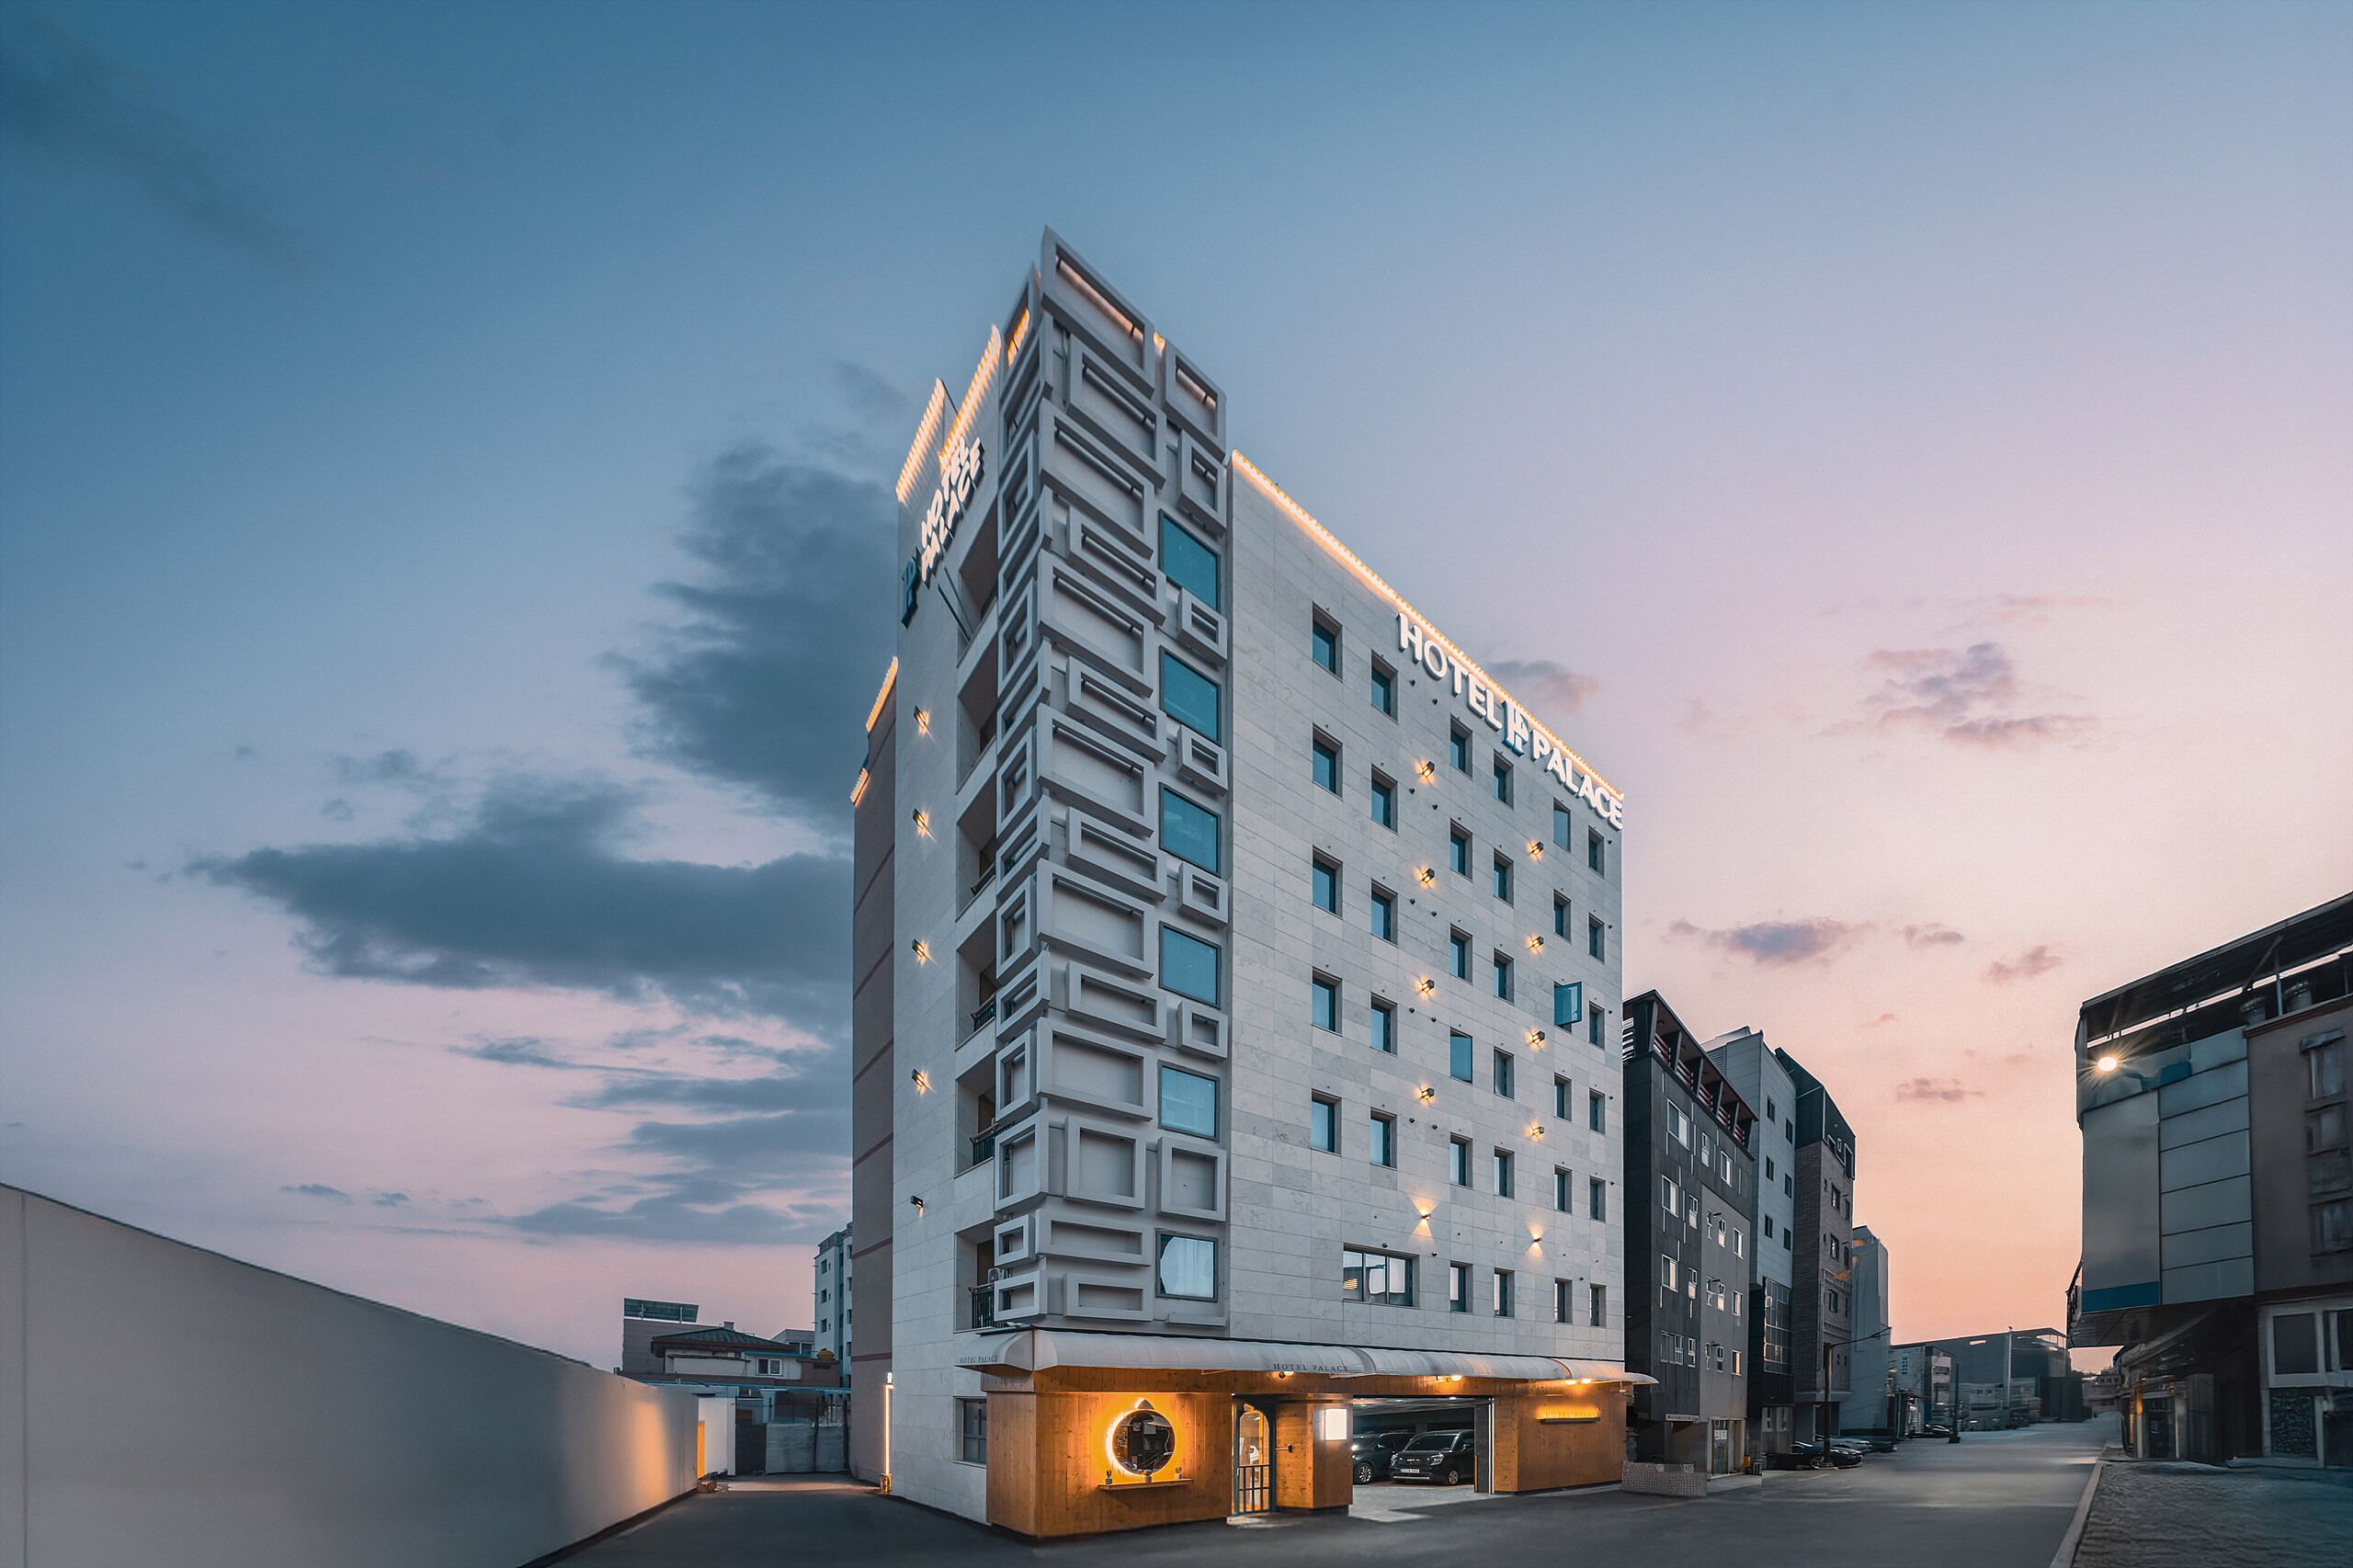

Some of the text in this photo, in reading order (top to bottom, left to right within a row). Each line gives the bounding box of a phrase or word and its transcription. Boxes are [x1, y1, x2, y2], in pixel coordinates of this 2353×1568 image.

[922, 436, 970, 550] HOTEL
[922, 437, 983, 585] PALACE
[1396, 611, 1502, 733] HOTEL
[1530, 730, 1623, 831] PALACE
[1273, 1363, 1307, 1371] HOTEL
